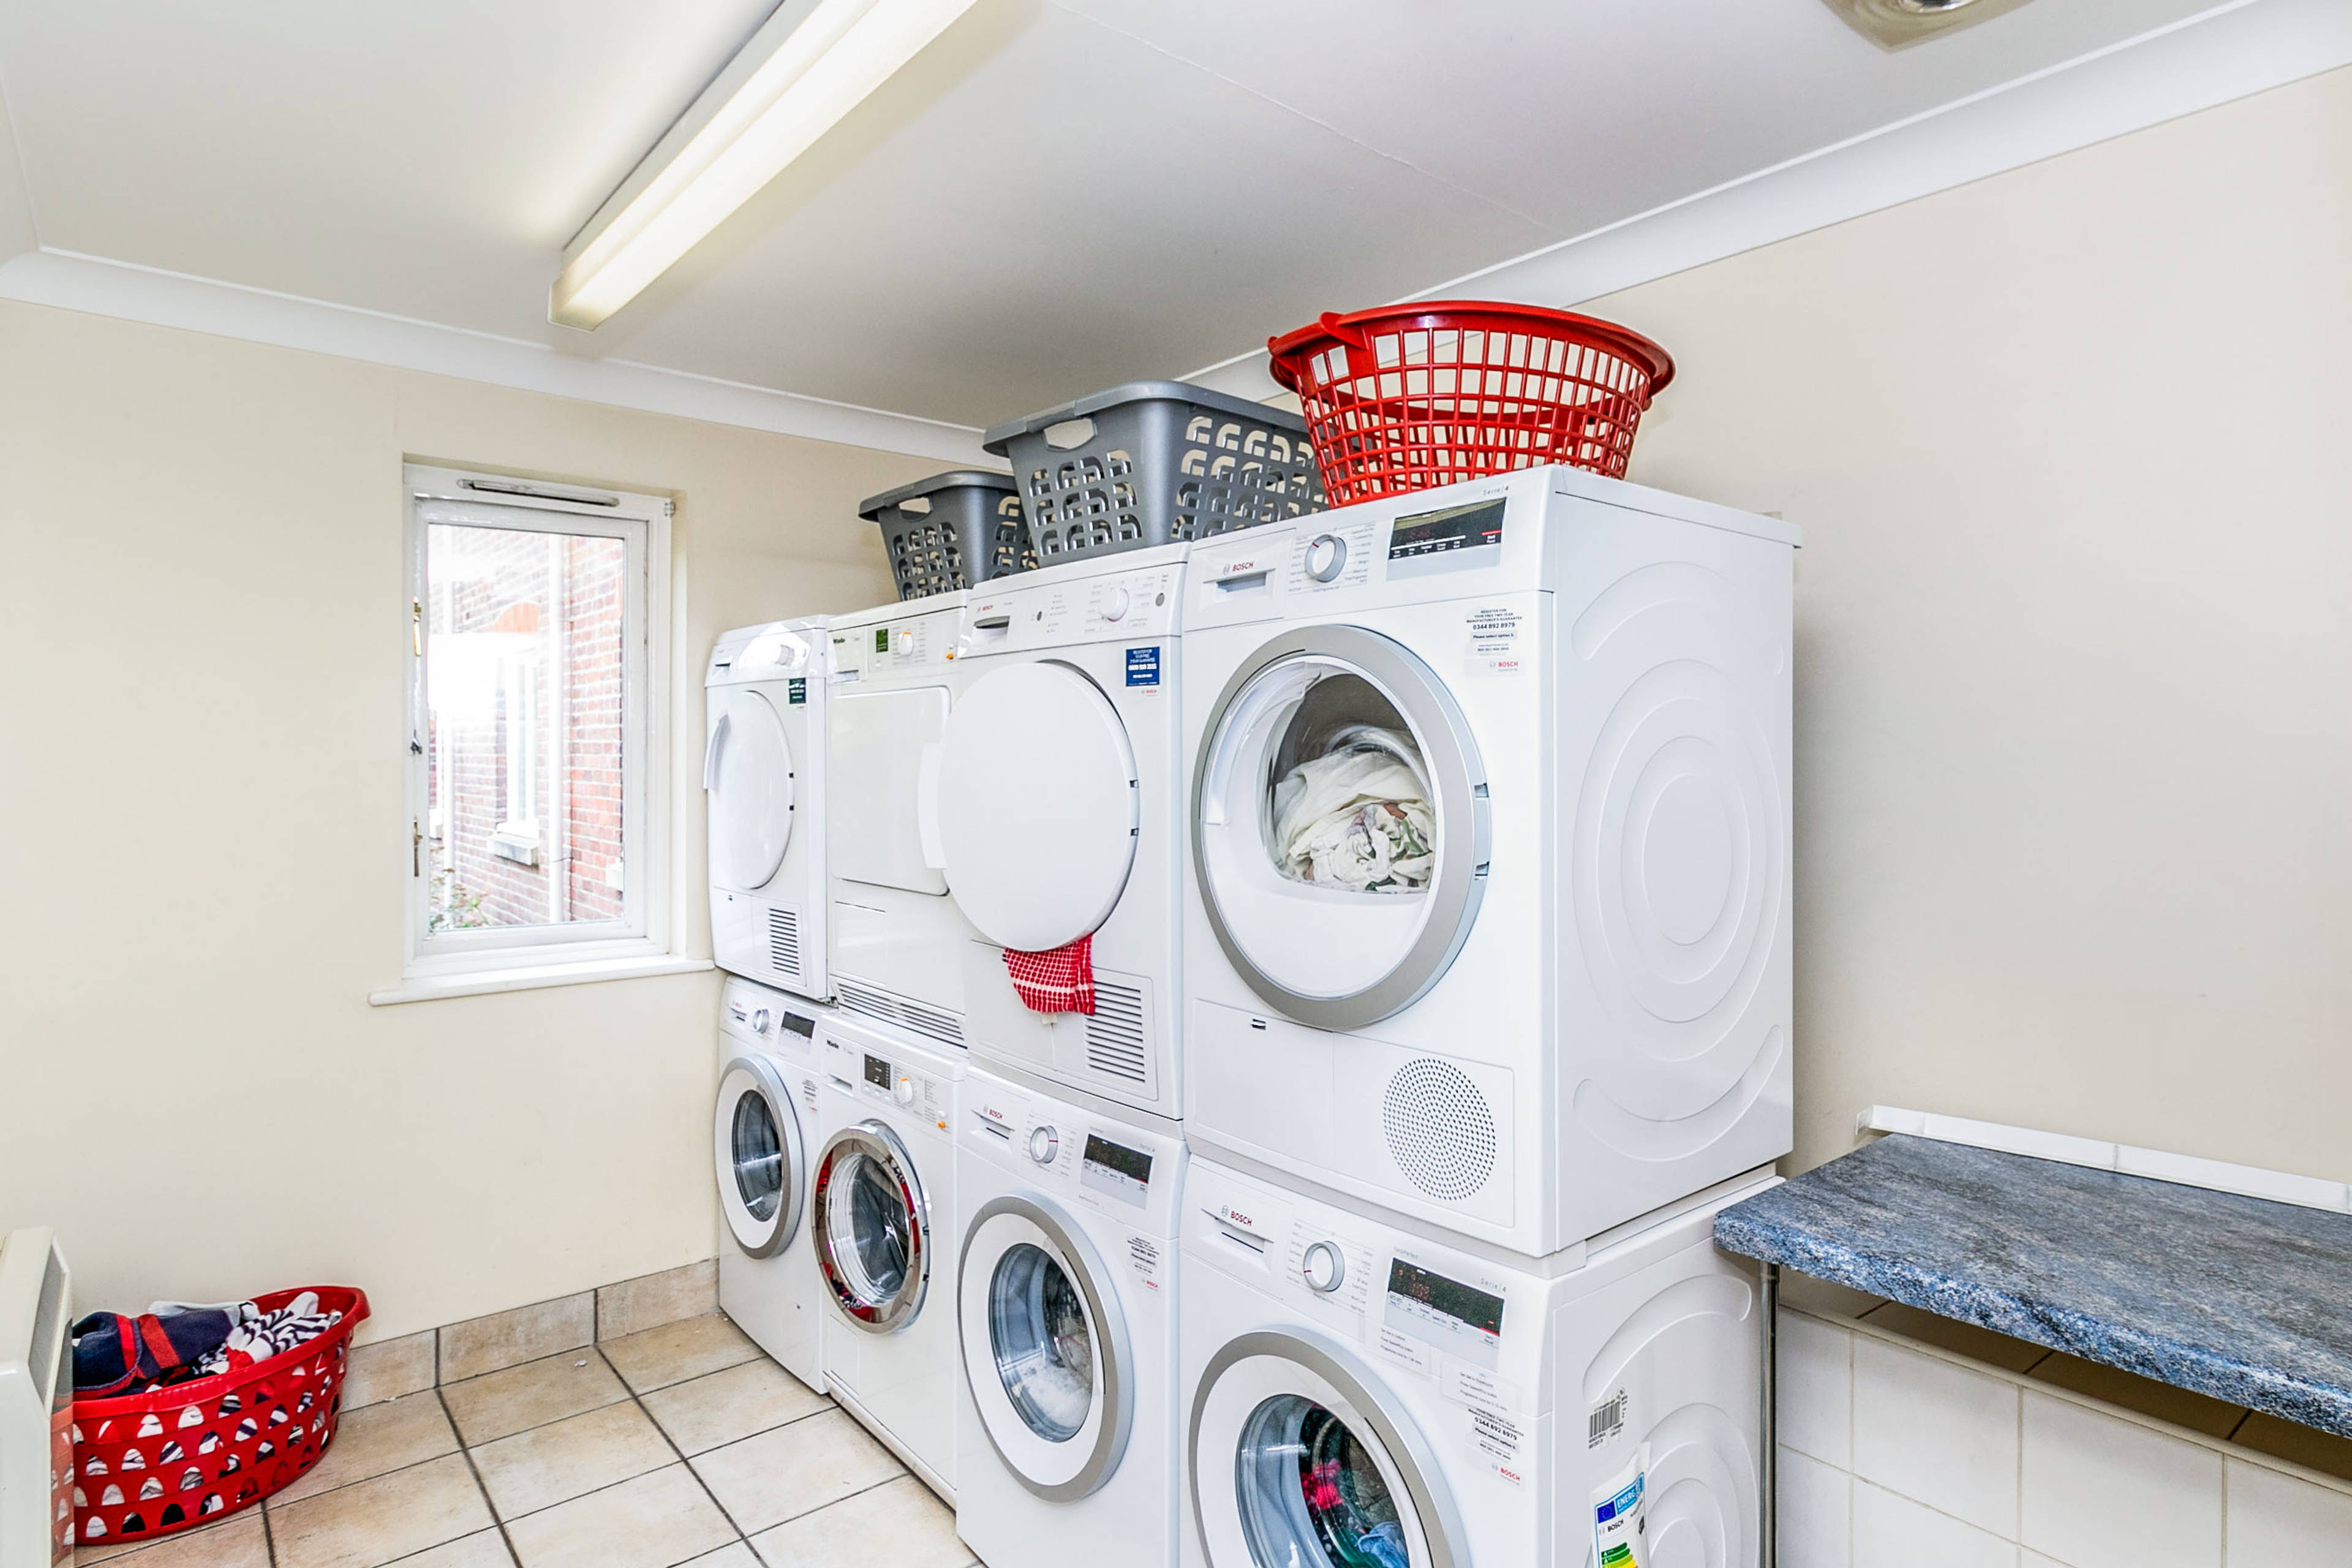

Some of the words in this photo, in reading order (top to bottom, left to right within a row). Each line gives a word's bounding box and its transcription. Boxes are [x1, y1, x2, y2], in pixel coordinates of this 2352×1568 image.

[1232, 561, 1254, 571] BOSCH
[989, 1109, 1003, 1120] BOSCH
[1231, 1210, 1253, 1227] BOSCH
[1474, 1417, 1490, 1428] 0344
[1490, 1423, 1501, 1433] 892
[1502, 1430, 1518, 1441] 8979
[1500, 1468, 1520, 1482] BOSCH
[1607, 1519, 1624, 1532] BOSCH
